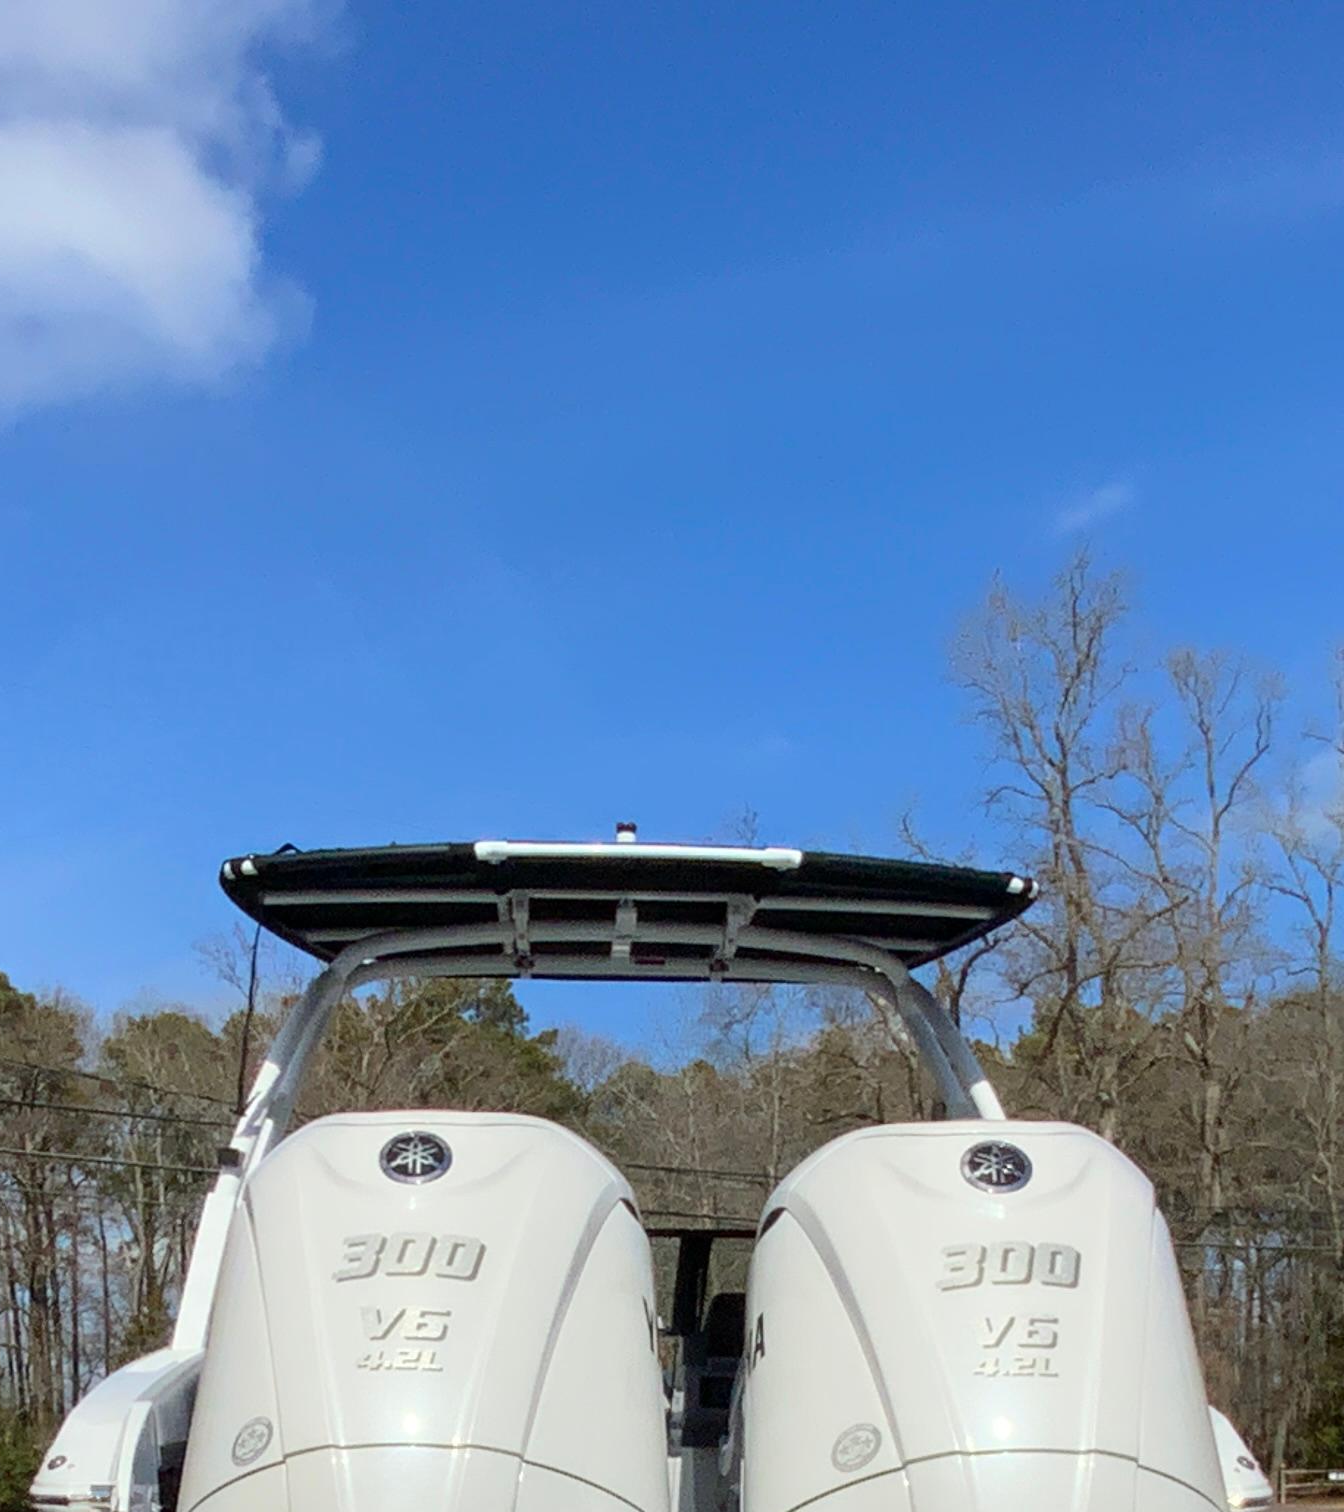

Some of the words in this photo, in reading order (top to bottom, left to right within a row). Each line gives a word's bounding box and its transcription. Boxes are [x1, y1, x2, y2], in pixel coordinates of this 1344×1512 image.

[333, 1231, 487, 1282] 300
[936, 1241, 1081, 1291] 300
[359, 1305, 452, 1342] V6
[979, 1317, 1060, 1349] V6
[357, 1349, 444, 1372] 4.2L
[974, 1357, 1060, 1378] 4.2L
